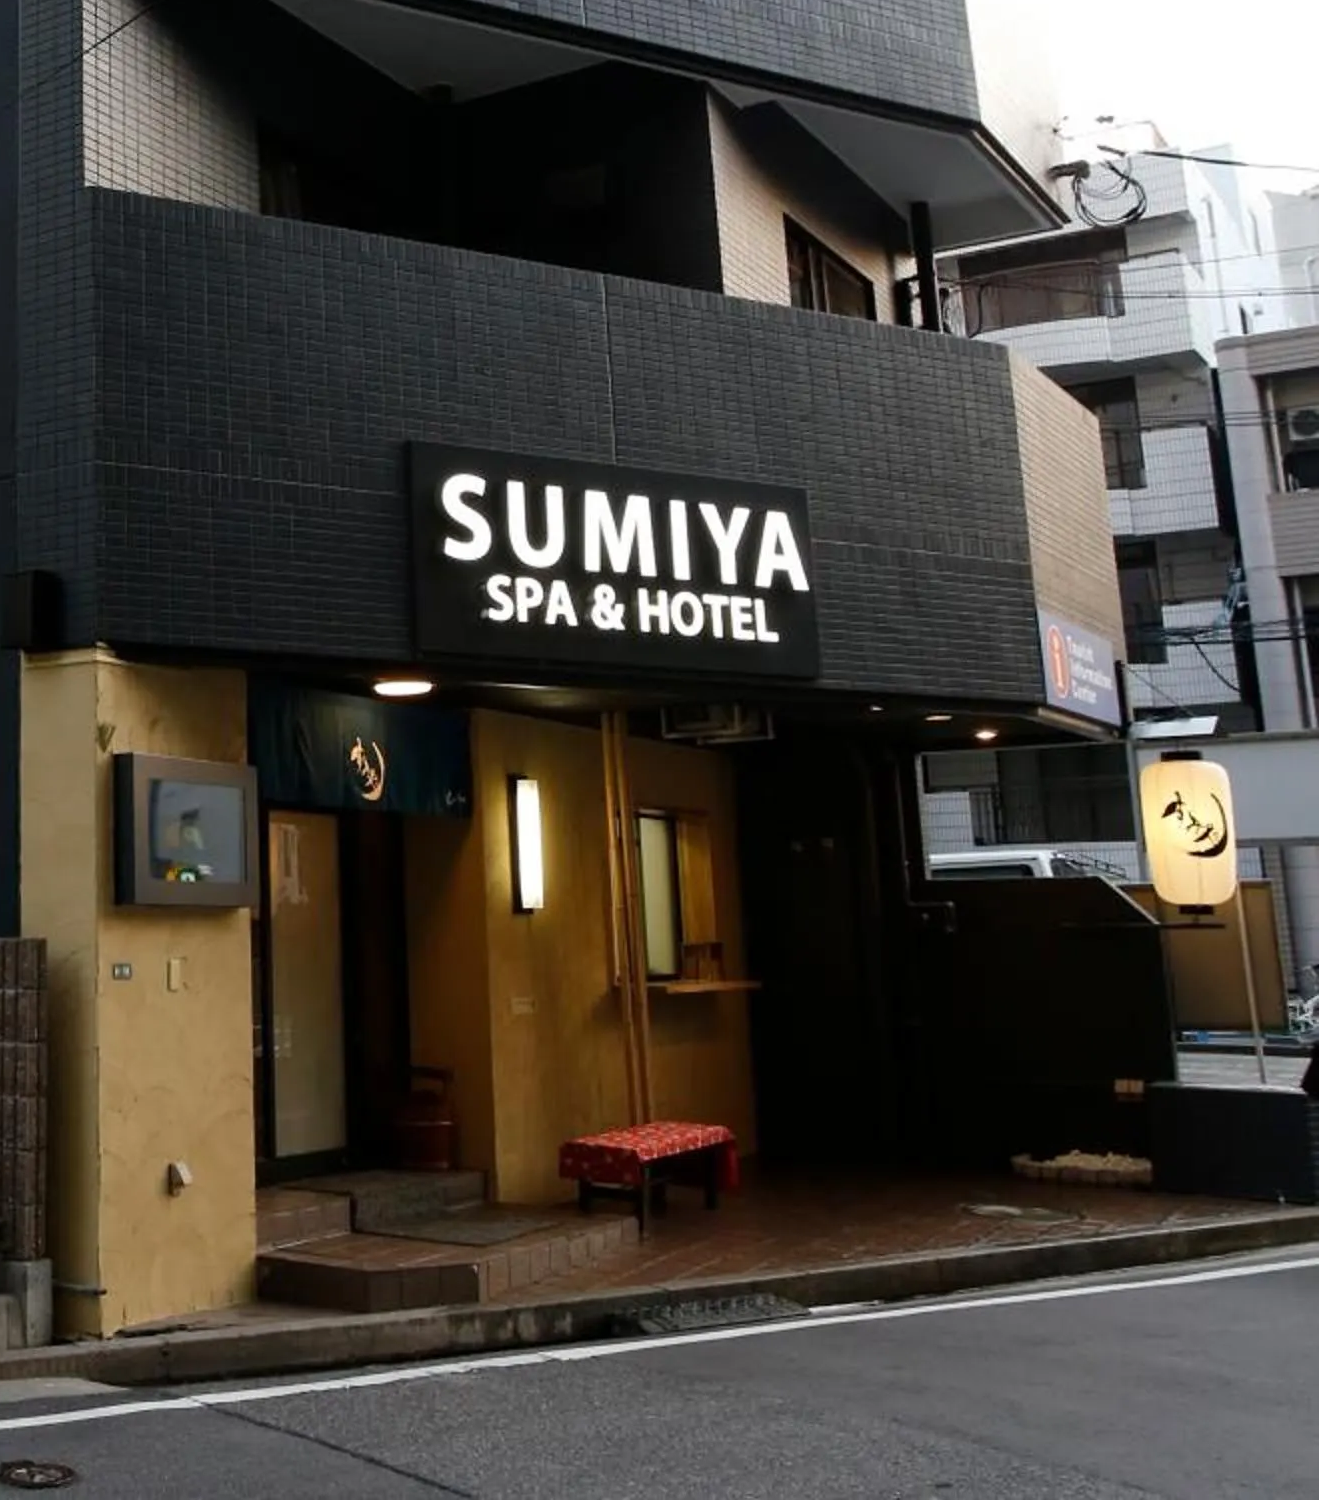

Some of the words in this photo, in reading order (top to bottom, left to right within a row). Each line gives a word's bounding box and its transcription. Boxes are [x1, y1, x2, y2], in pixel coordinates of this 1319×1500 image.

[440, 473, 811, 592] SUMIYA
[485, 574, 578, 628] SPA
[590, 583, 626, 631] &
[638, 587, 780, 643] HOTEL
